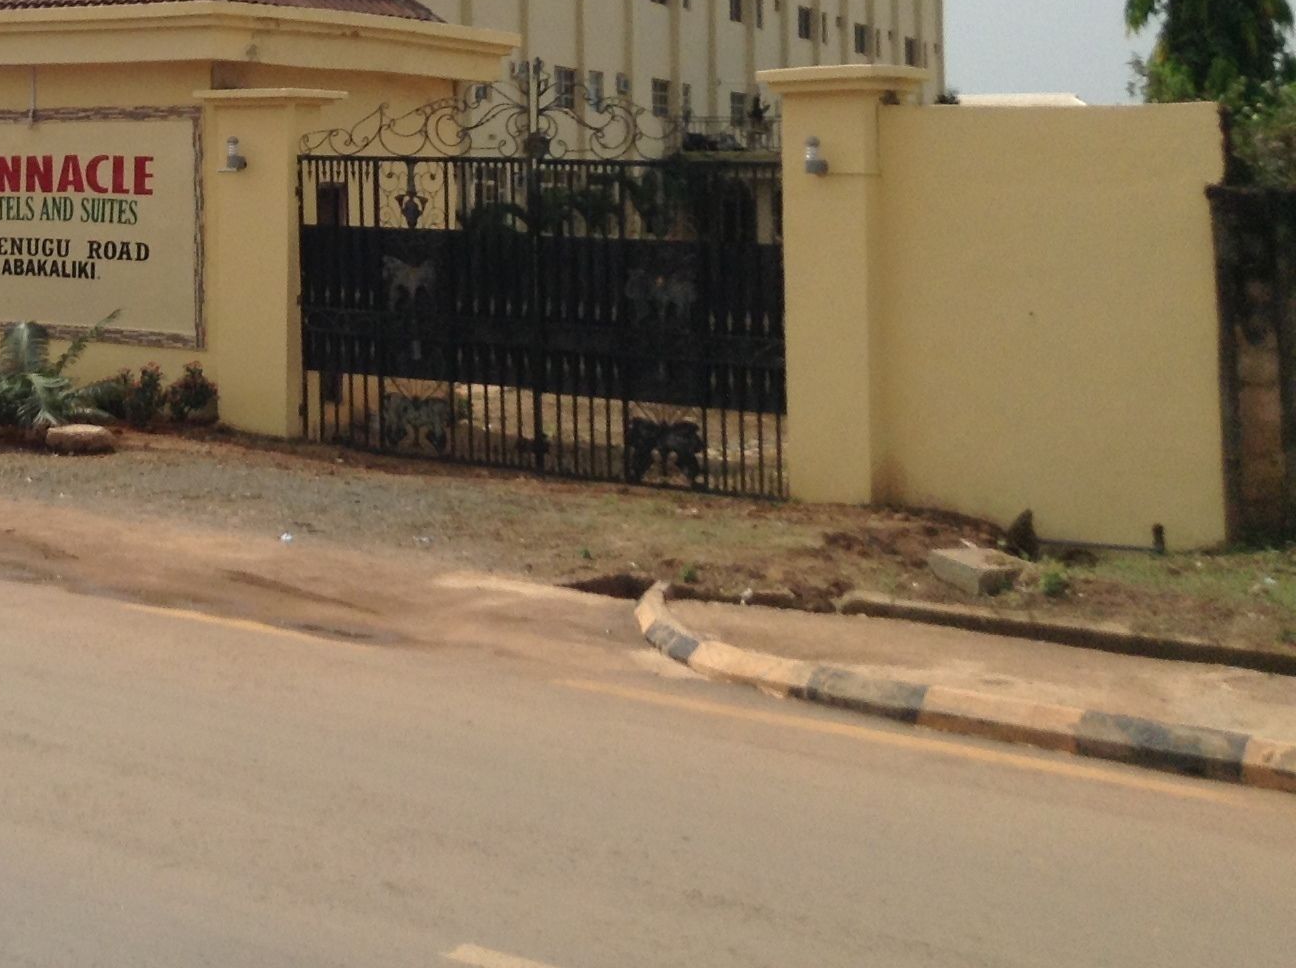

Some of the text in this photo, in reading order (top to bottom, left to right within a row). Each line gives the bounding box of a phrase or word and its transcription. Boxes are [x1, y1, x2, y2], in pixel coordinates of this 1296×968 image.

[40, 197, 74, 222] AND
[80, 198, 138, 225] SUITES
[87, 240, 150, 262] ROAD
